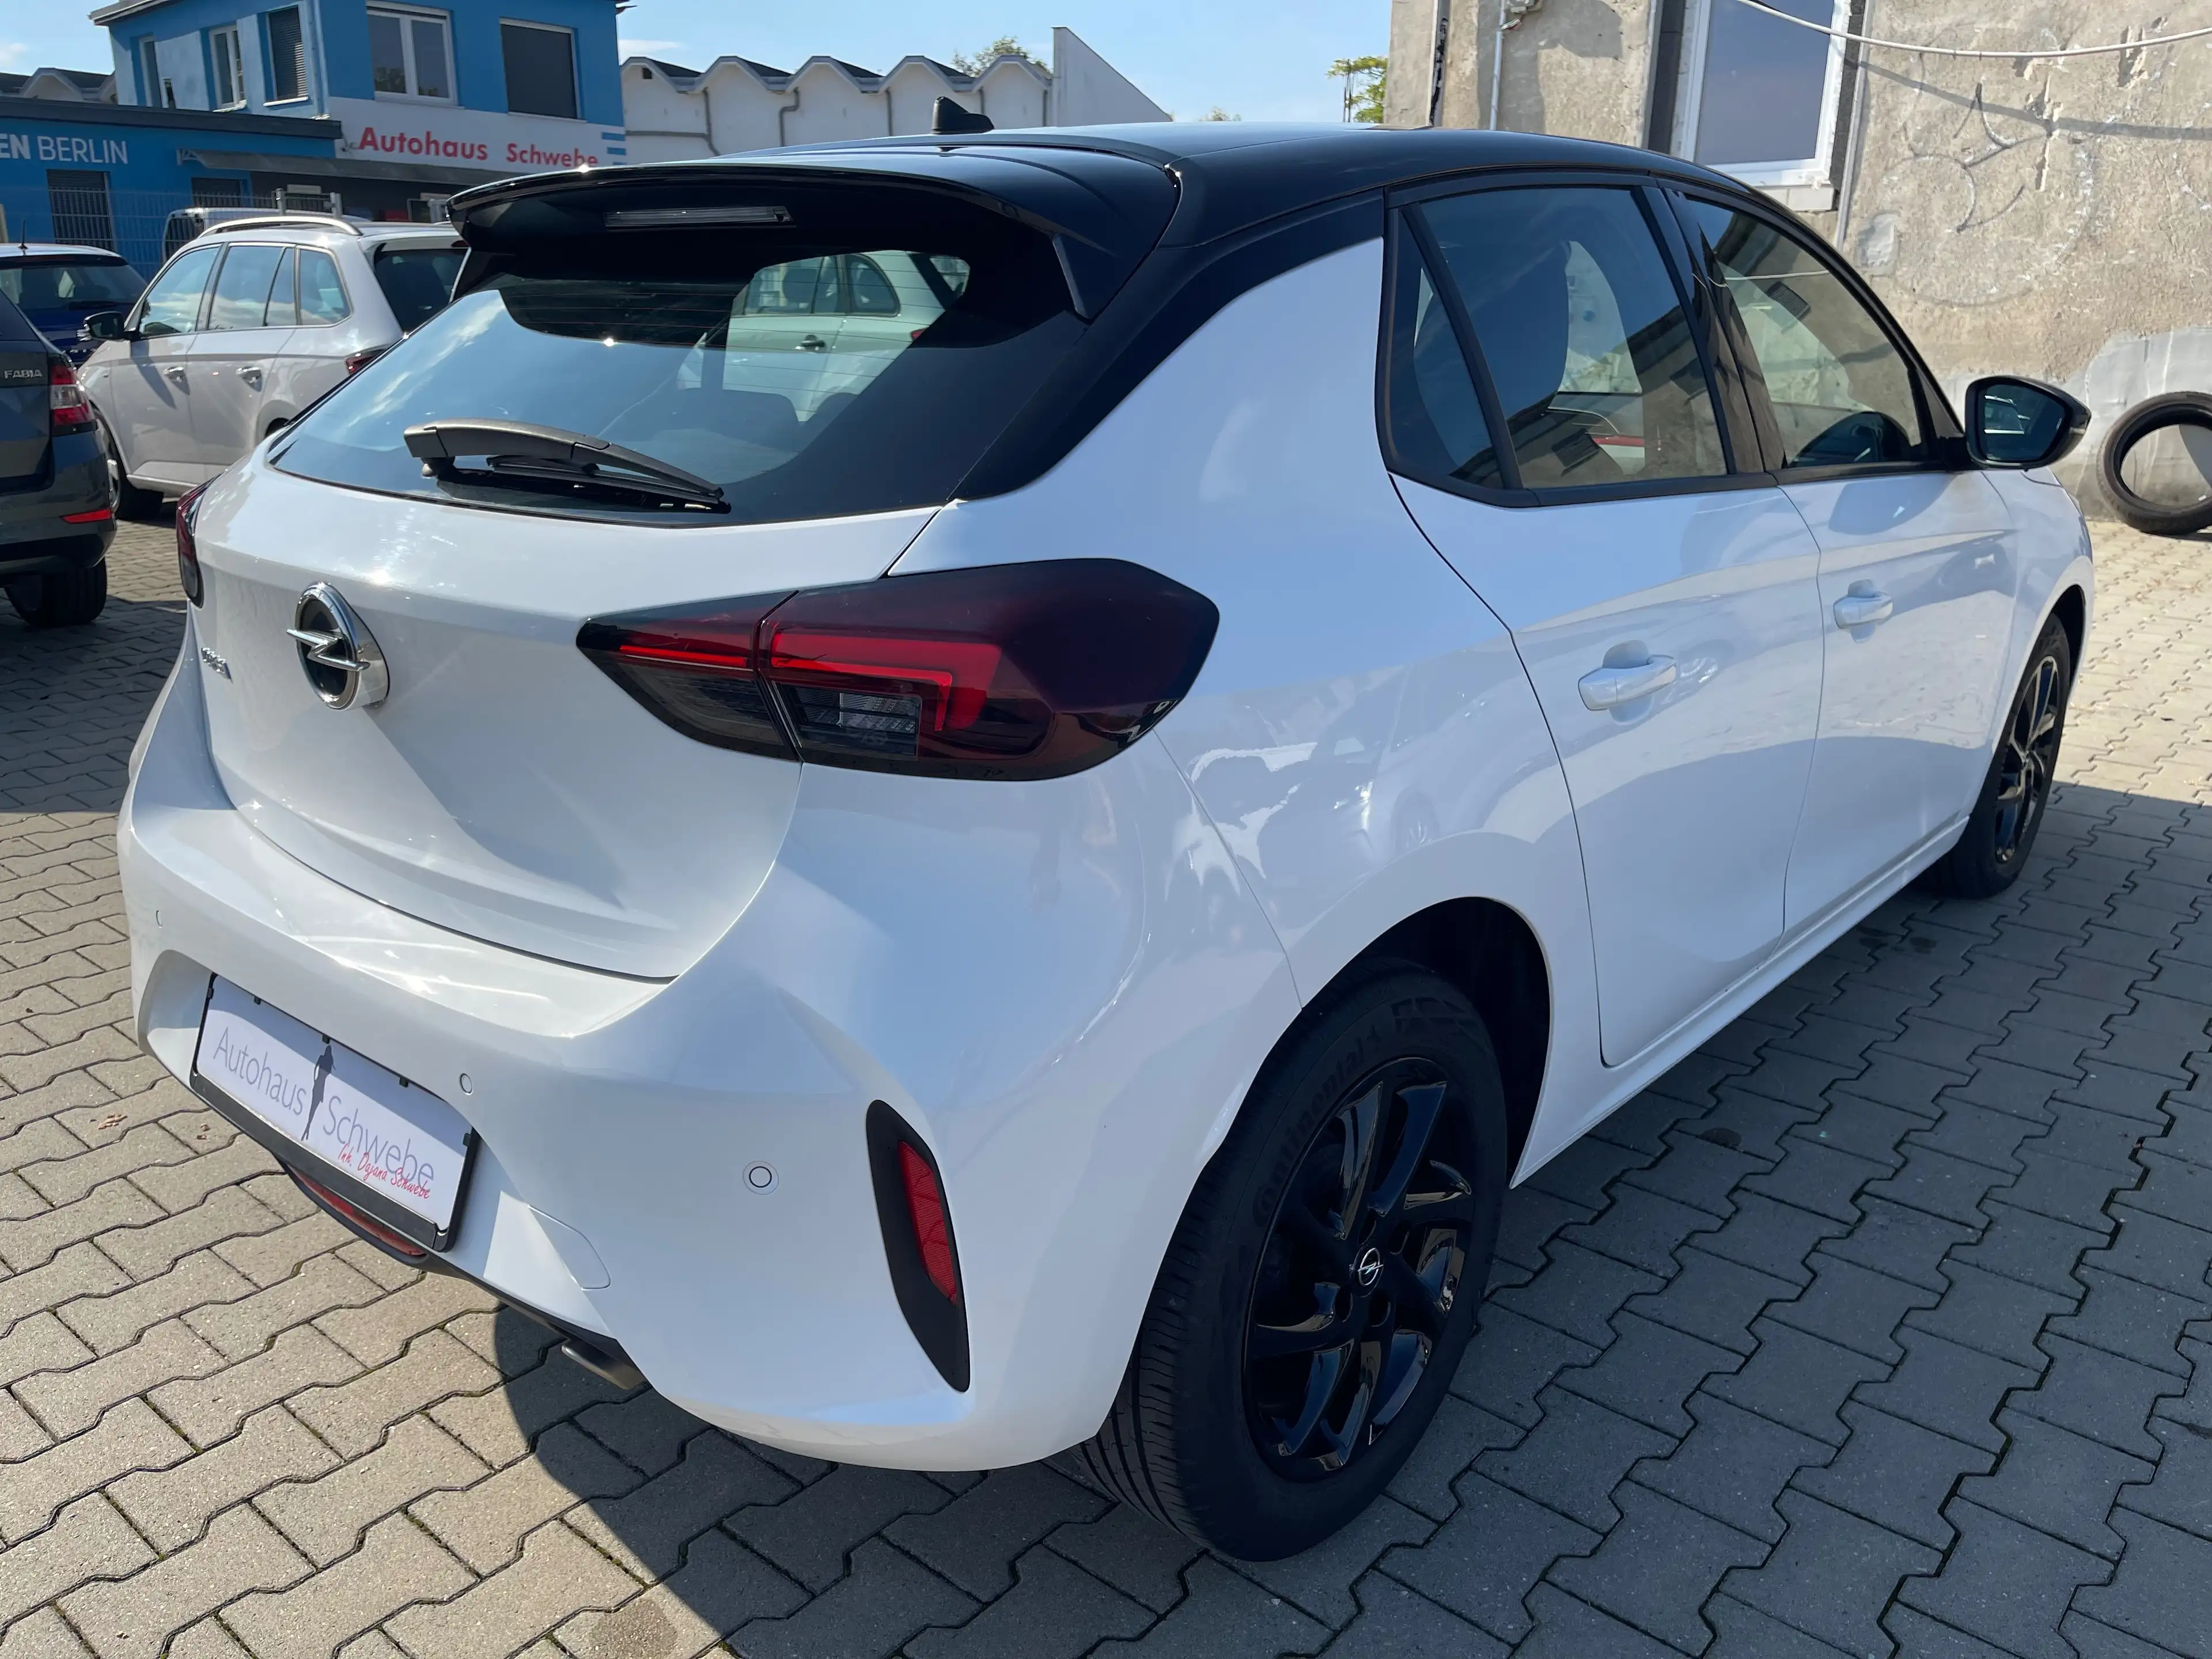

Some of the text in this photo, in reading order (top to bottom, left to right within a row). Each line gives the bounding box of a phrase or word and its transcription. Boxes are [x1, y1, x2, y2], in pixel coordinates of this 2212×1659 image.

[37, 136, 128, 164] BERLIN
[359, 127, 598, 168] Autohaus Schwebe
[4, 369, 43, 378] FABIA
[213, 1026, 434, 1191] Autohaus Schwebe
[1252, 1036, 1365, 1227] Continental
[391, 1165, 431, 1199] Schwebe
